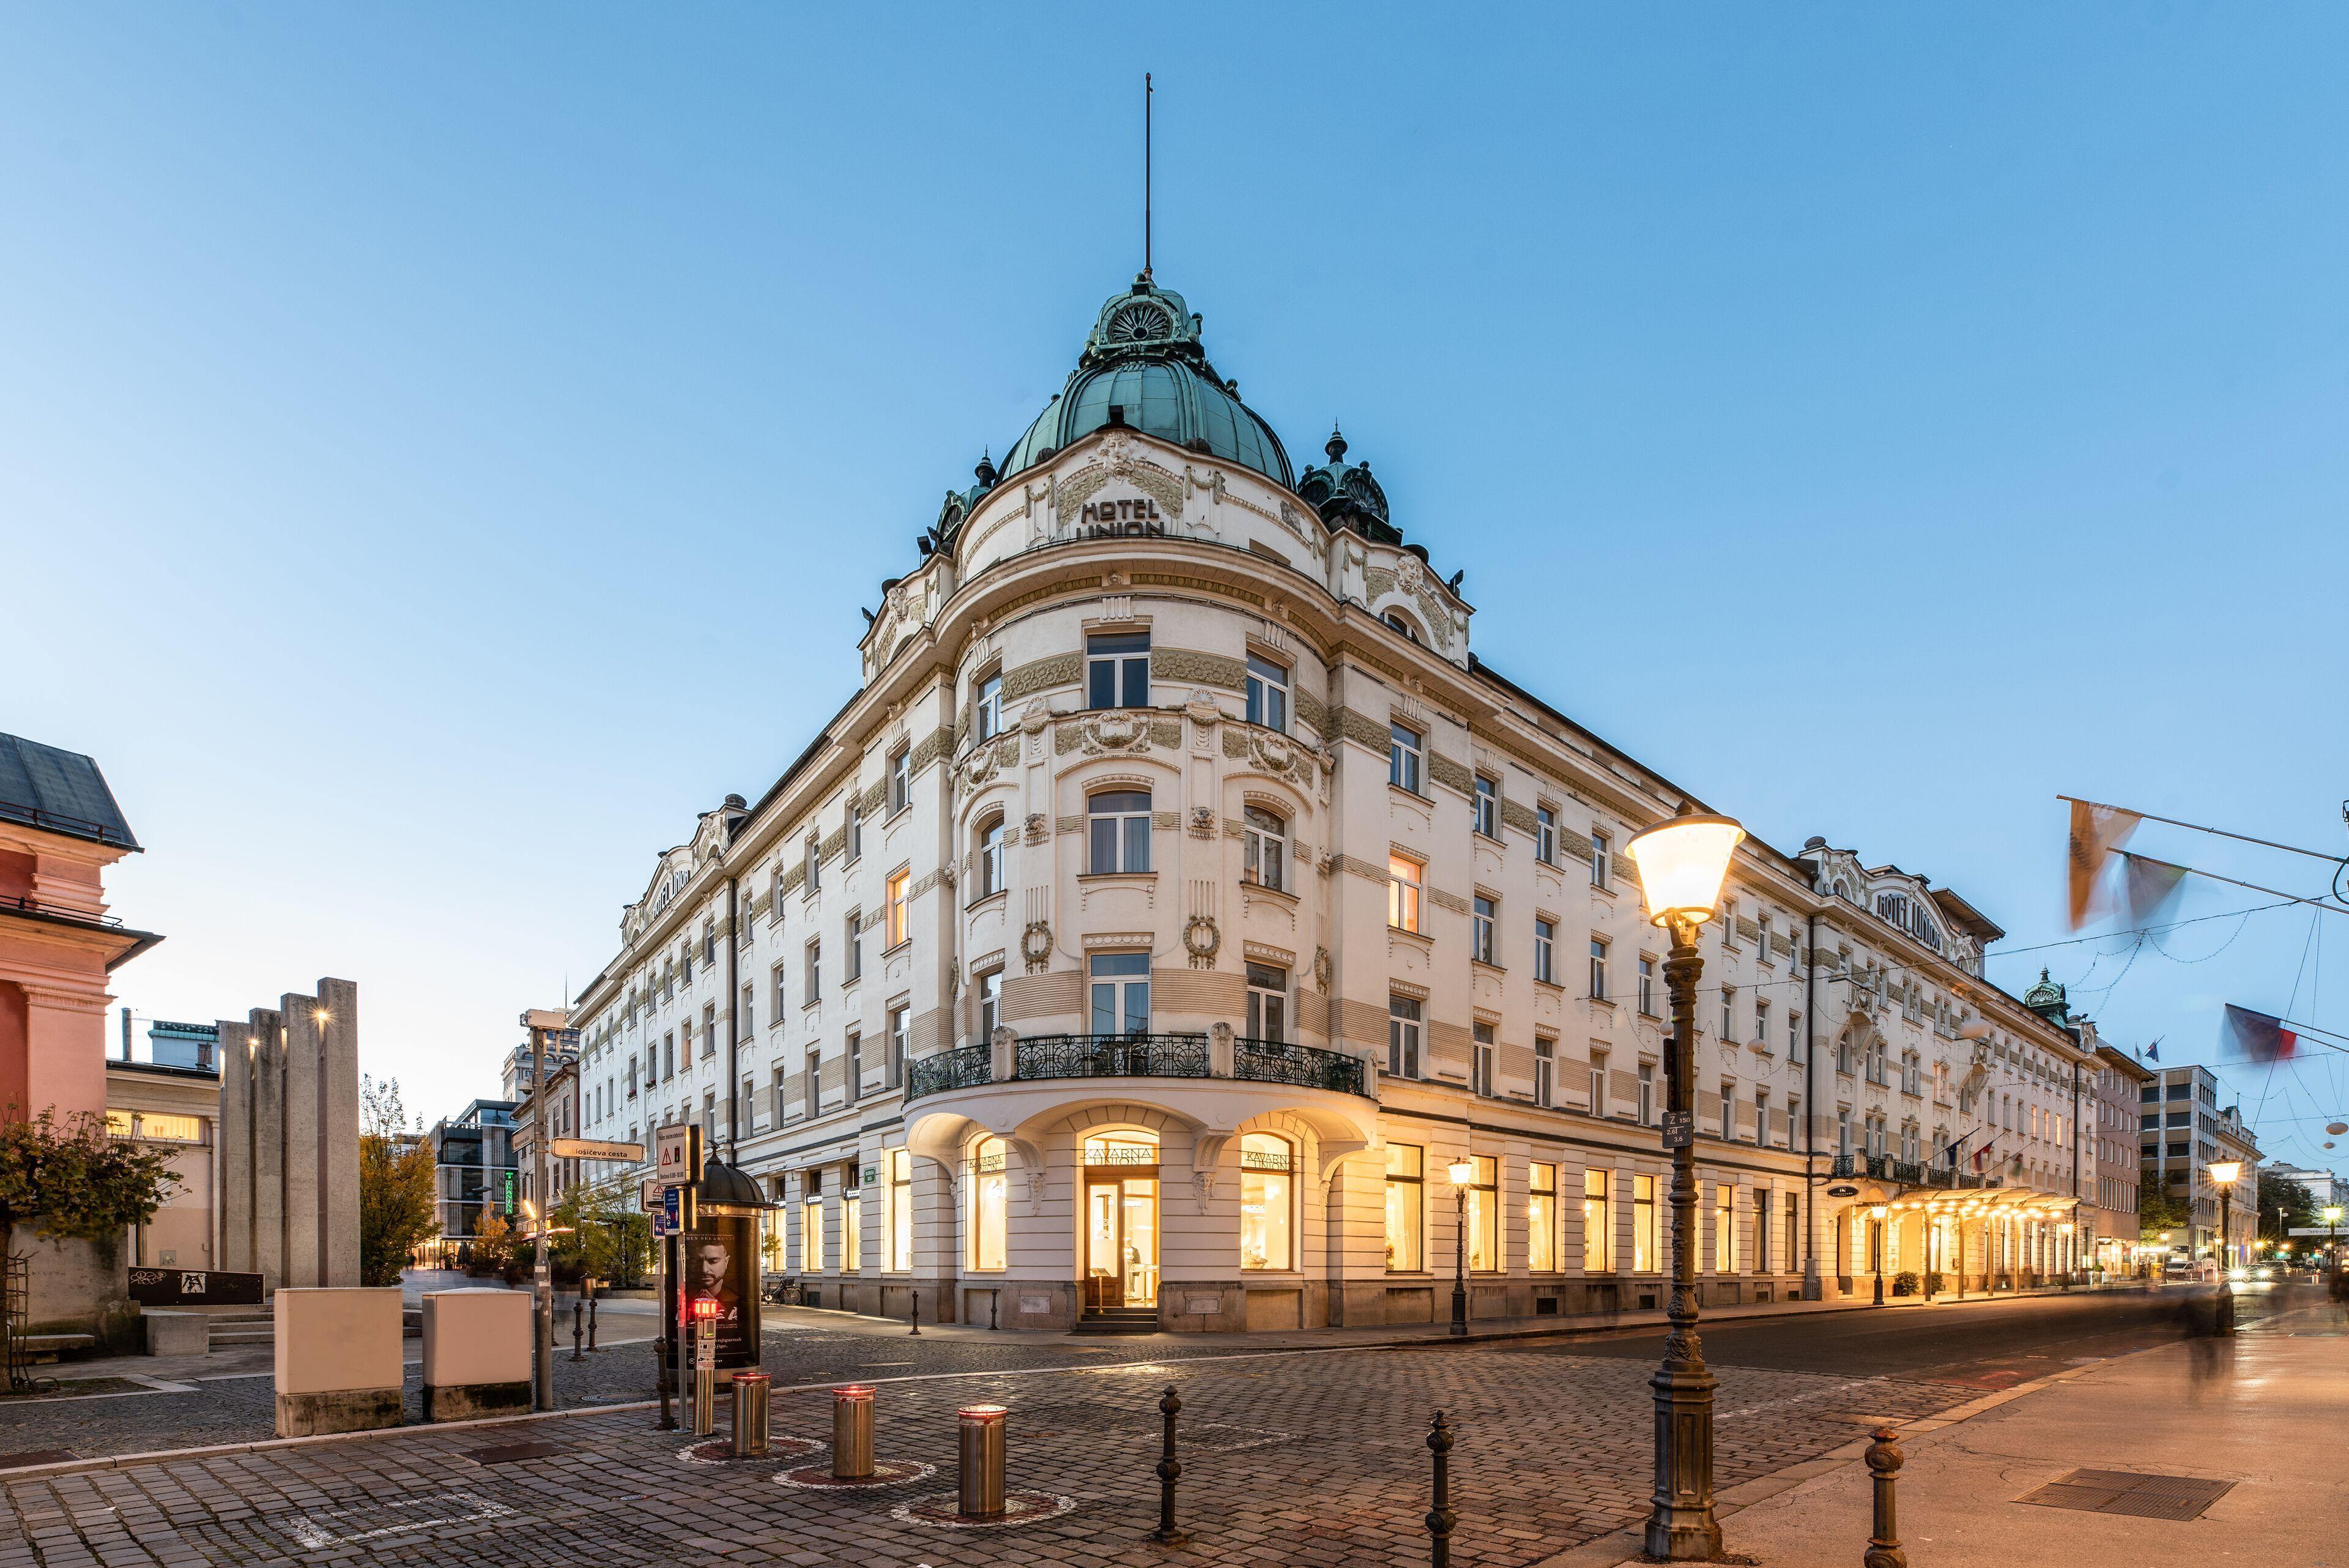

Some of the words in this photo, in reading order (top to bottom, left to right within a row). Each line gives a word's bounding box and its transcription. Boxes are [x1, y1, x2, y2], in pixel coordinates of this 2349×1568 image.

[1081, 499, 1159, 524] HOTEL
[1076, 521, 1165, 540] UNION
[653, 882, 671, 919] HOTEL
[671, 869, 691, 899] UNION
[1877, 893, 1912, 933] HOTEL
[1912, 902, 1942, 951] UNION
[1669, 1116, 1675, 1124] Z
[1084, 1148, 1151, 1159] KAVARNA
[1247, 1151, 1296, 1165] KAVARNA
[1094, 1157, 1140, 1165] UNION
[1254, 1160, 1287, 1170] UNION
